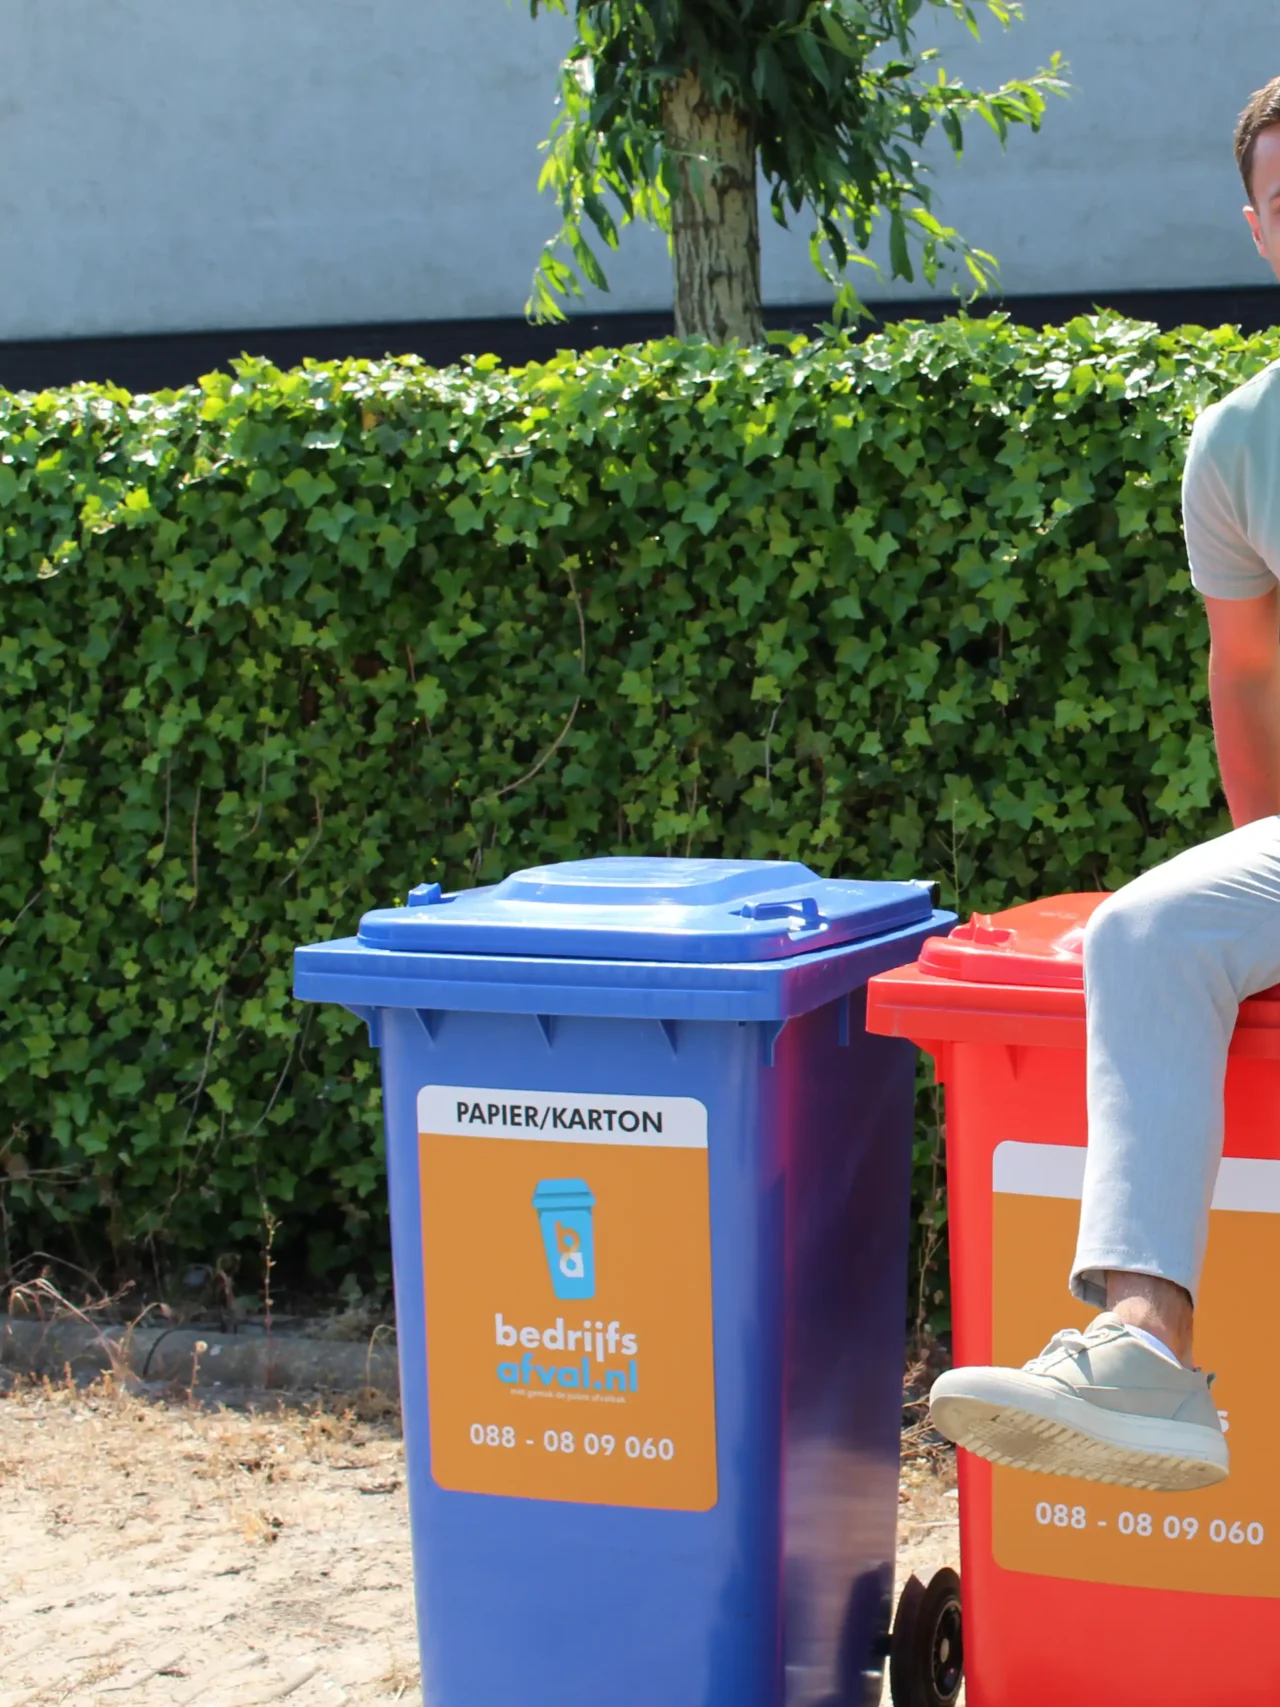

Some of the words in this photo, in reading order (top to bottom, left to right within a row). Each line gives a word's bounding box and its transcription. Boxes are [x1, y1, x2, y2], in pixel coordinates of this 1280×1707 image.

[456, 1101, 663, 1133] PAPIER/KARTON
[494, 1312, 638, 1363] bedrijfs
[497, 1352, 639, 1392] afval.nl
[470, 1423, 516, 1448] 088
[543, 1430, 575, 1454] 08
[584, 1433, 616, 1456] 09
[625, 1436, 675, 1460] 060
[1035, 1502, 1087, 1529] 088
[1118, 1512, 1153, 1537] 08
[1163, 1515, 1199, 1540] 09
[1209, 1519, 1265, 1546] 060
